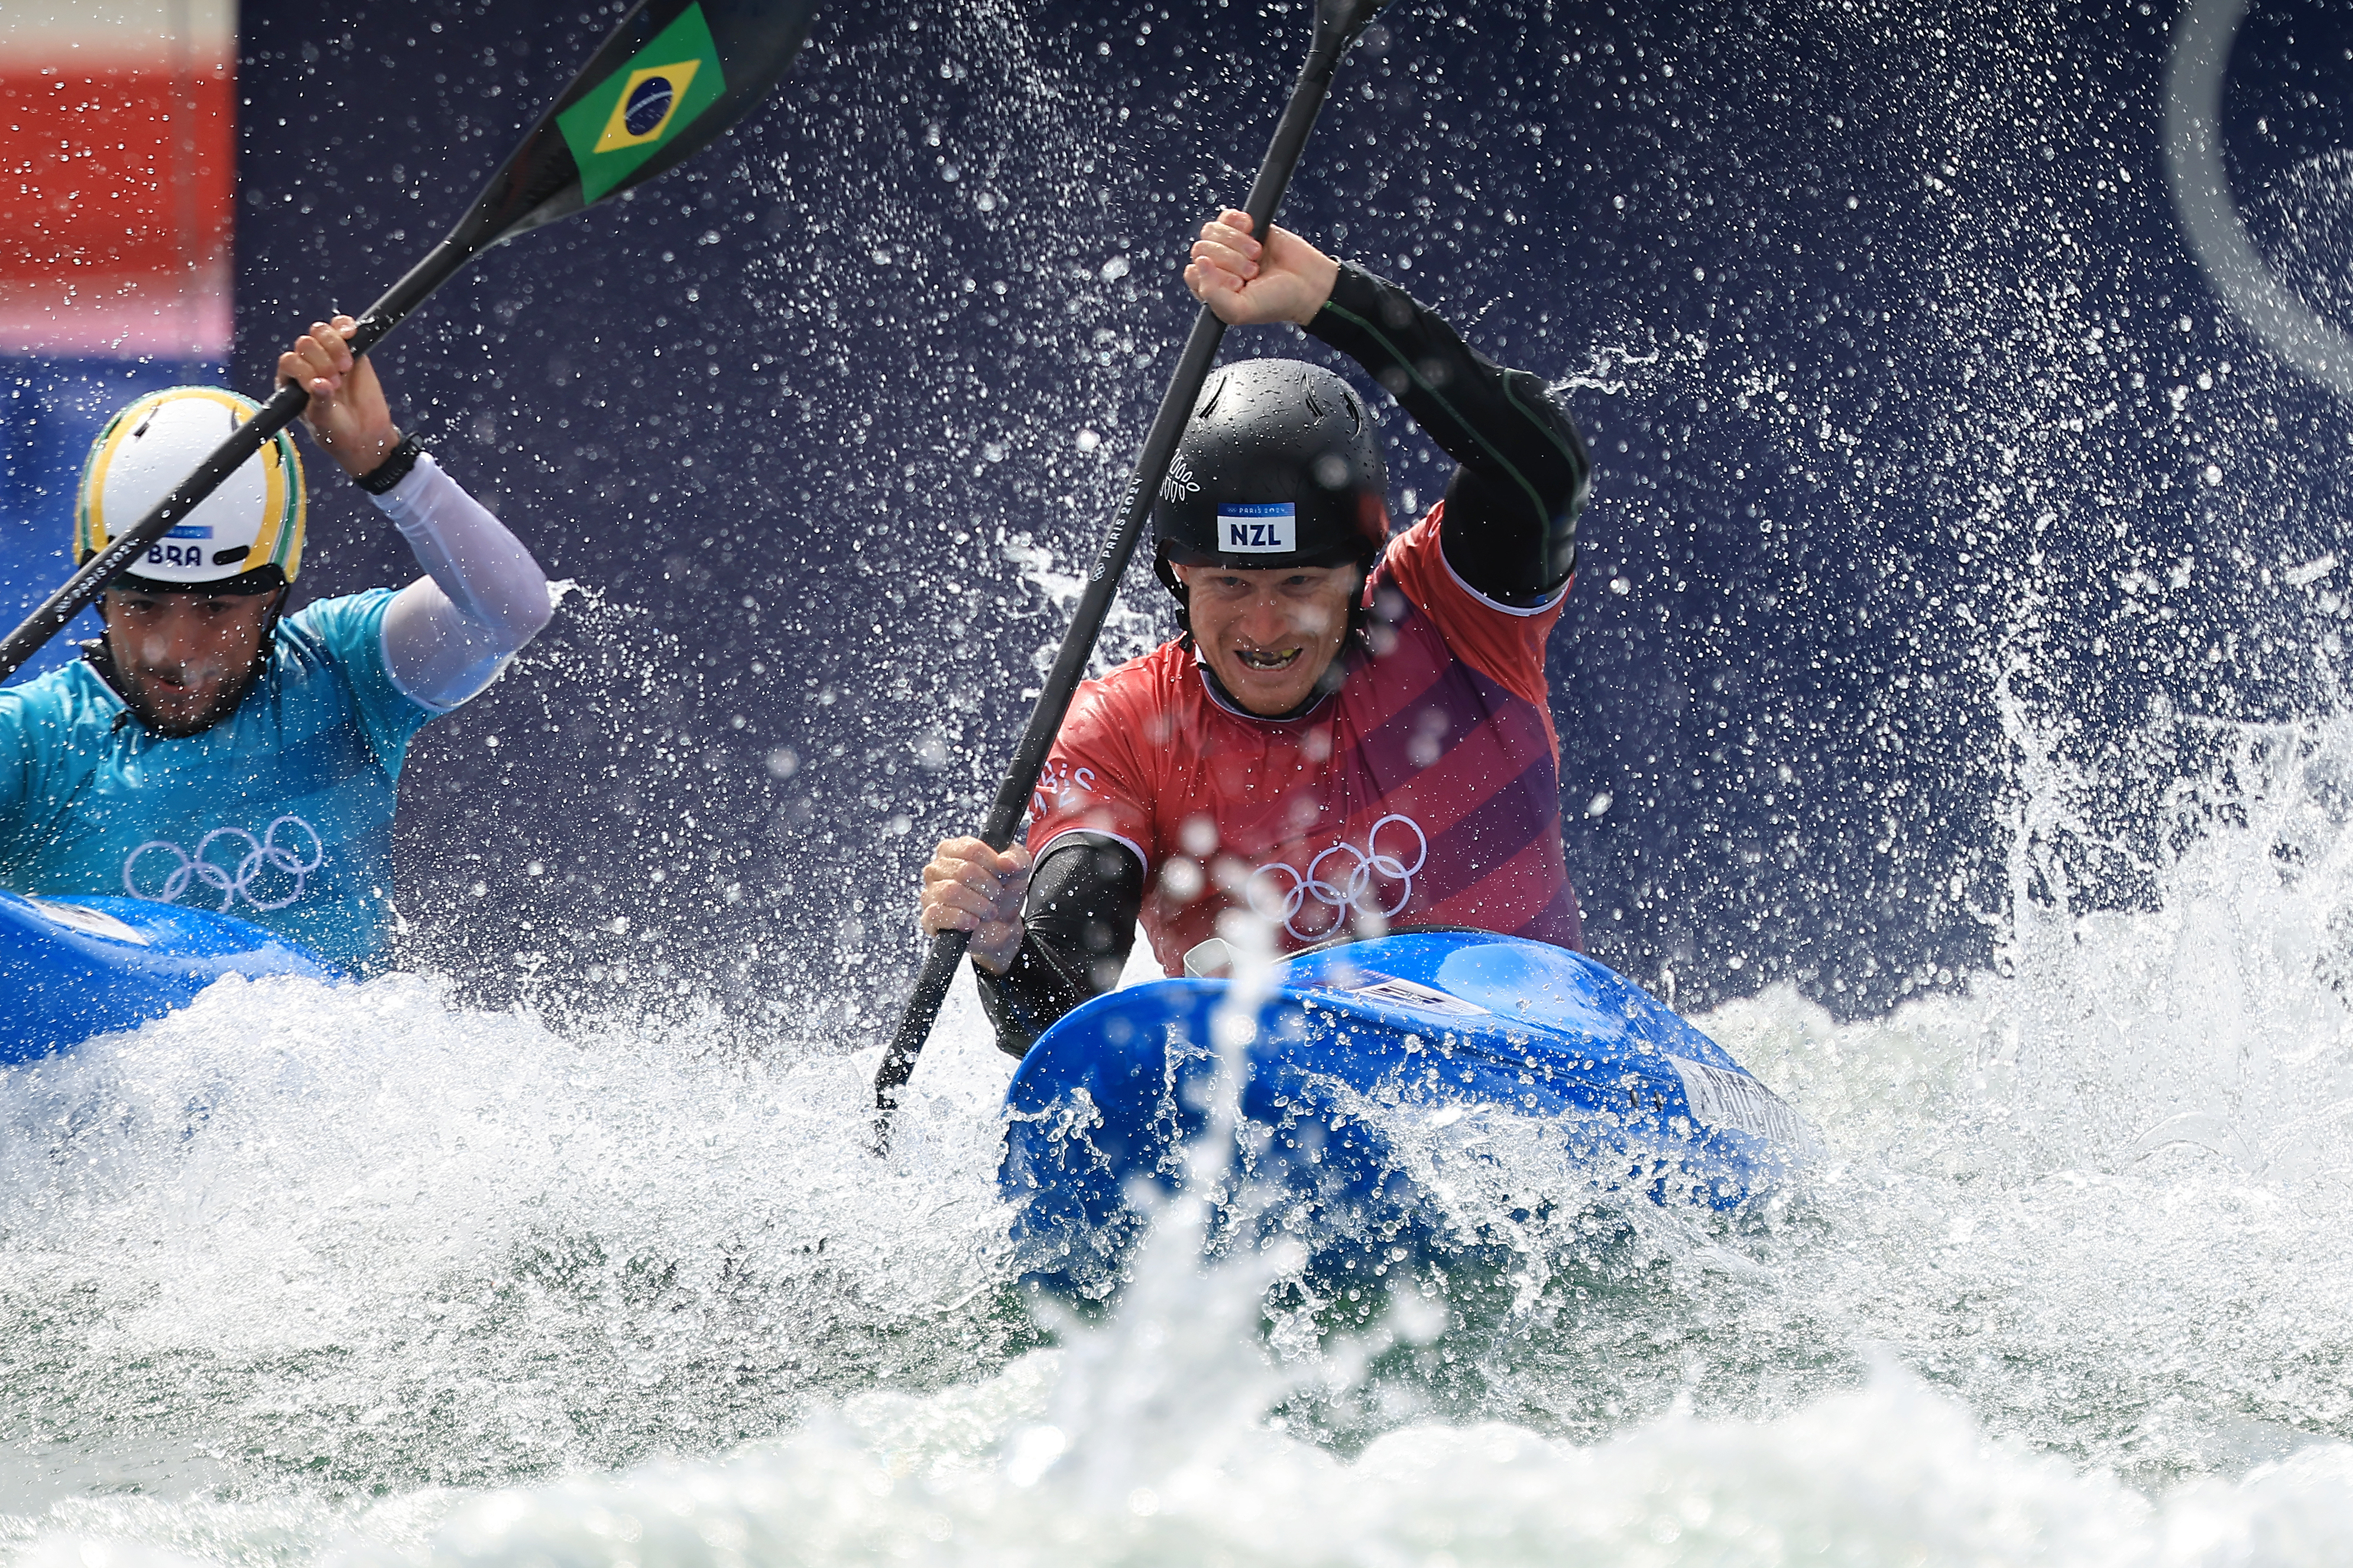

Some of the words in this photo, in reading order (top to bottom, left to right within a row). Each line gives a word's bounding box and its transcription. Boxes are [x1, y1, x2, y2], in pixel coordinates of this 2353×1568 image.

[1103, 517, 1125, 559] PARIS
[1120, 475, 1143, 515] 2024
[1230, 524, 1281, 546] NZL
[148, 544, 201, 566] BRA
[72, 566, 108, 599] PARIS
